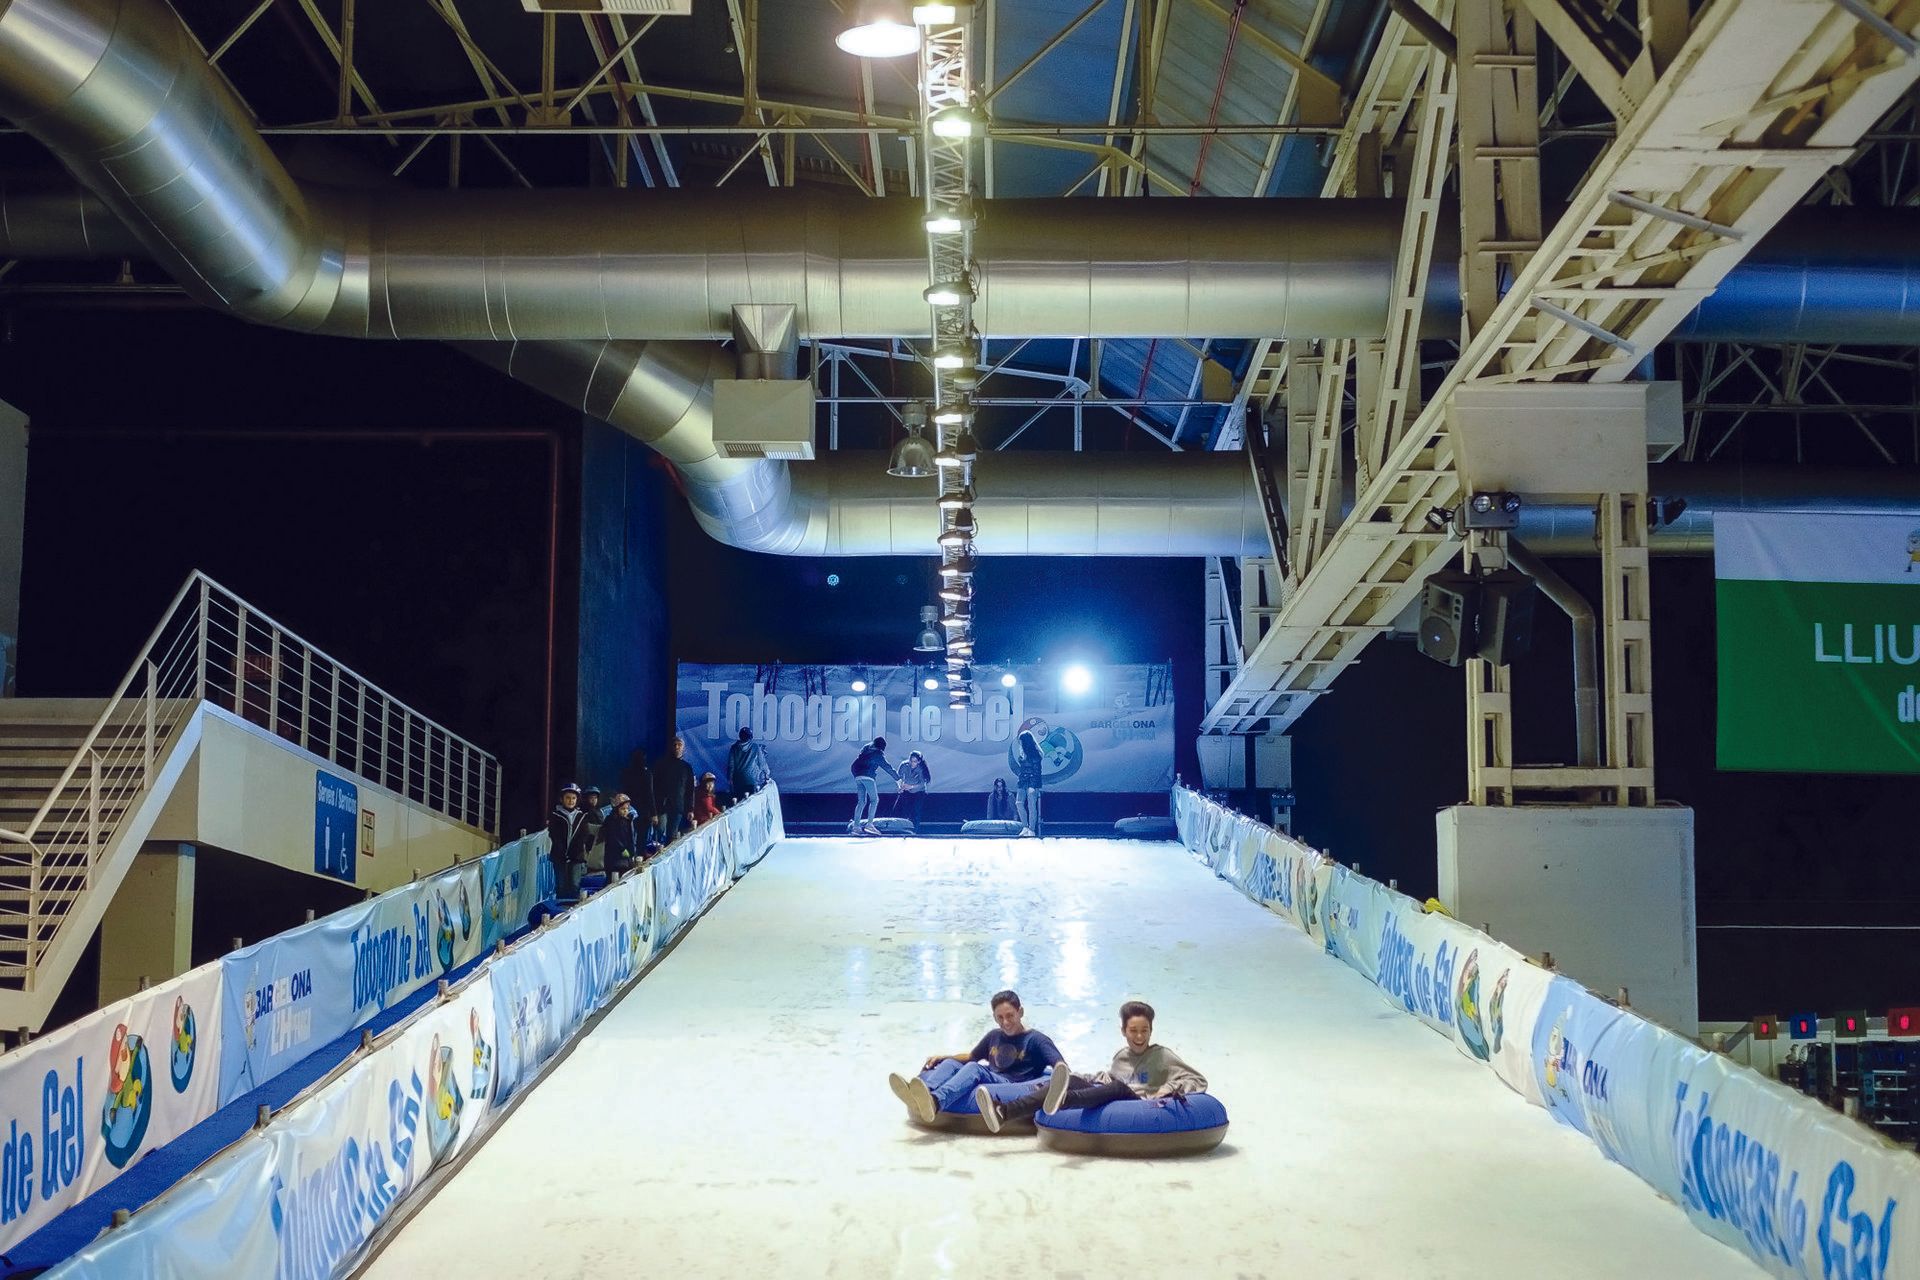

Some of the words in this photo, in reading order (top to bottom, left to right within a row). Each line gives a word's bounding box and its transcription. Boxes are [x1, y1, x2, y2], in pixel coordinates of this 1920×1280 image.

[701, 682, 887, 751] Tobogan
[901, 697, 942, 742] de
[1897, 685, 1920, 722] d
[2, 1119, 33, 1225] de
[41, 1056, 84, 1200] Gel
